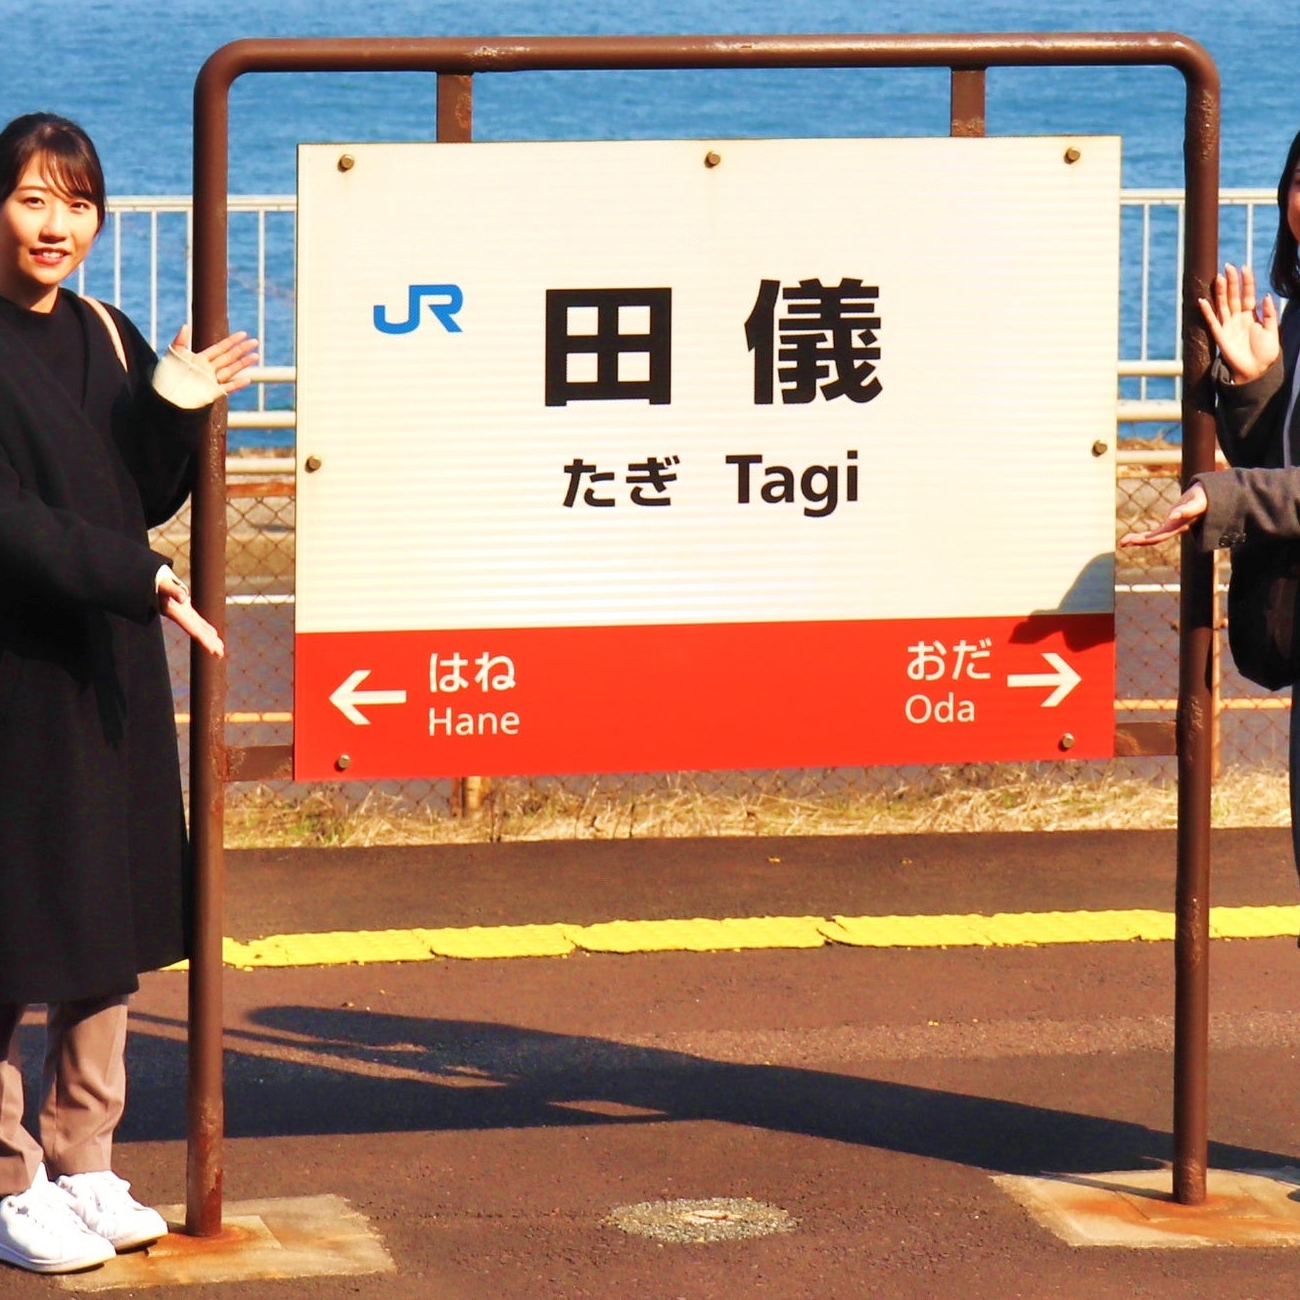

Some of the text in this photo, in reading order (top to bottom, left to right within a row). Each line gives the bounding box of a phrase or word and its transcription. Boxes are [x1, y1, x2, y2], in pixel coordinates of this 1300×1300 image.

[373, 284, 464, 335] JR
[544, 277, 884, 407] 田儀
[562, 450, 859, 518] たぎ Tagi
[428, 651, 517, 693] はね
[905, 638, 993, 682] おだ
[427, 706, 521, 736] Hane
[904, 691, 976, 724] Oda
